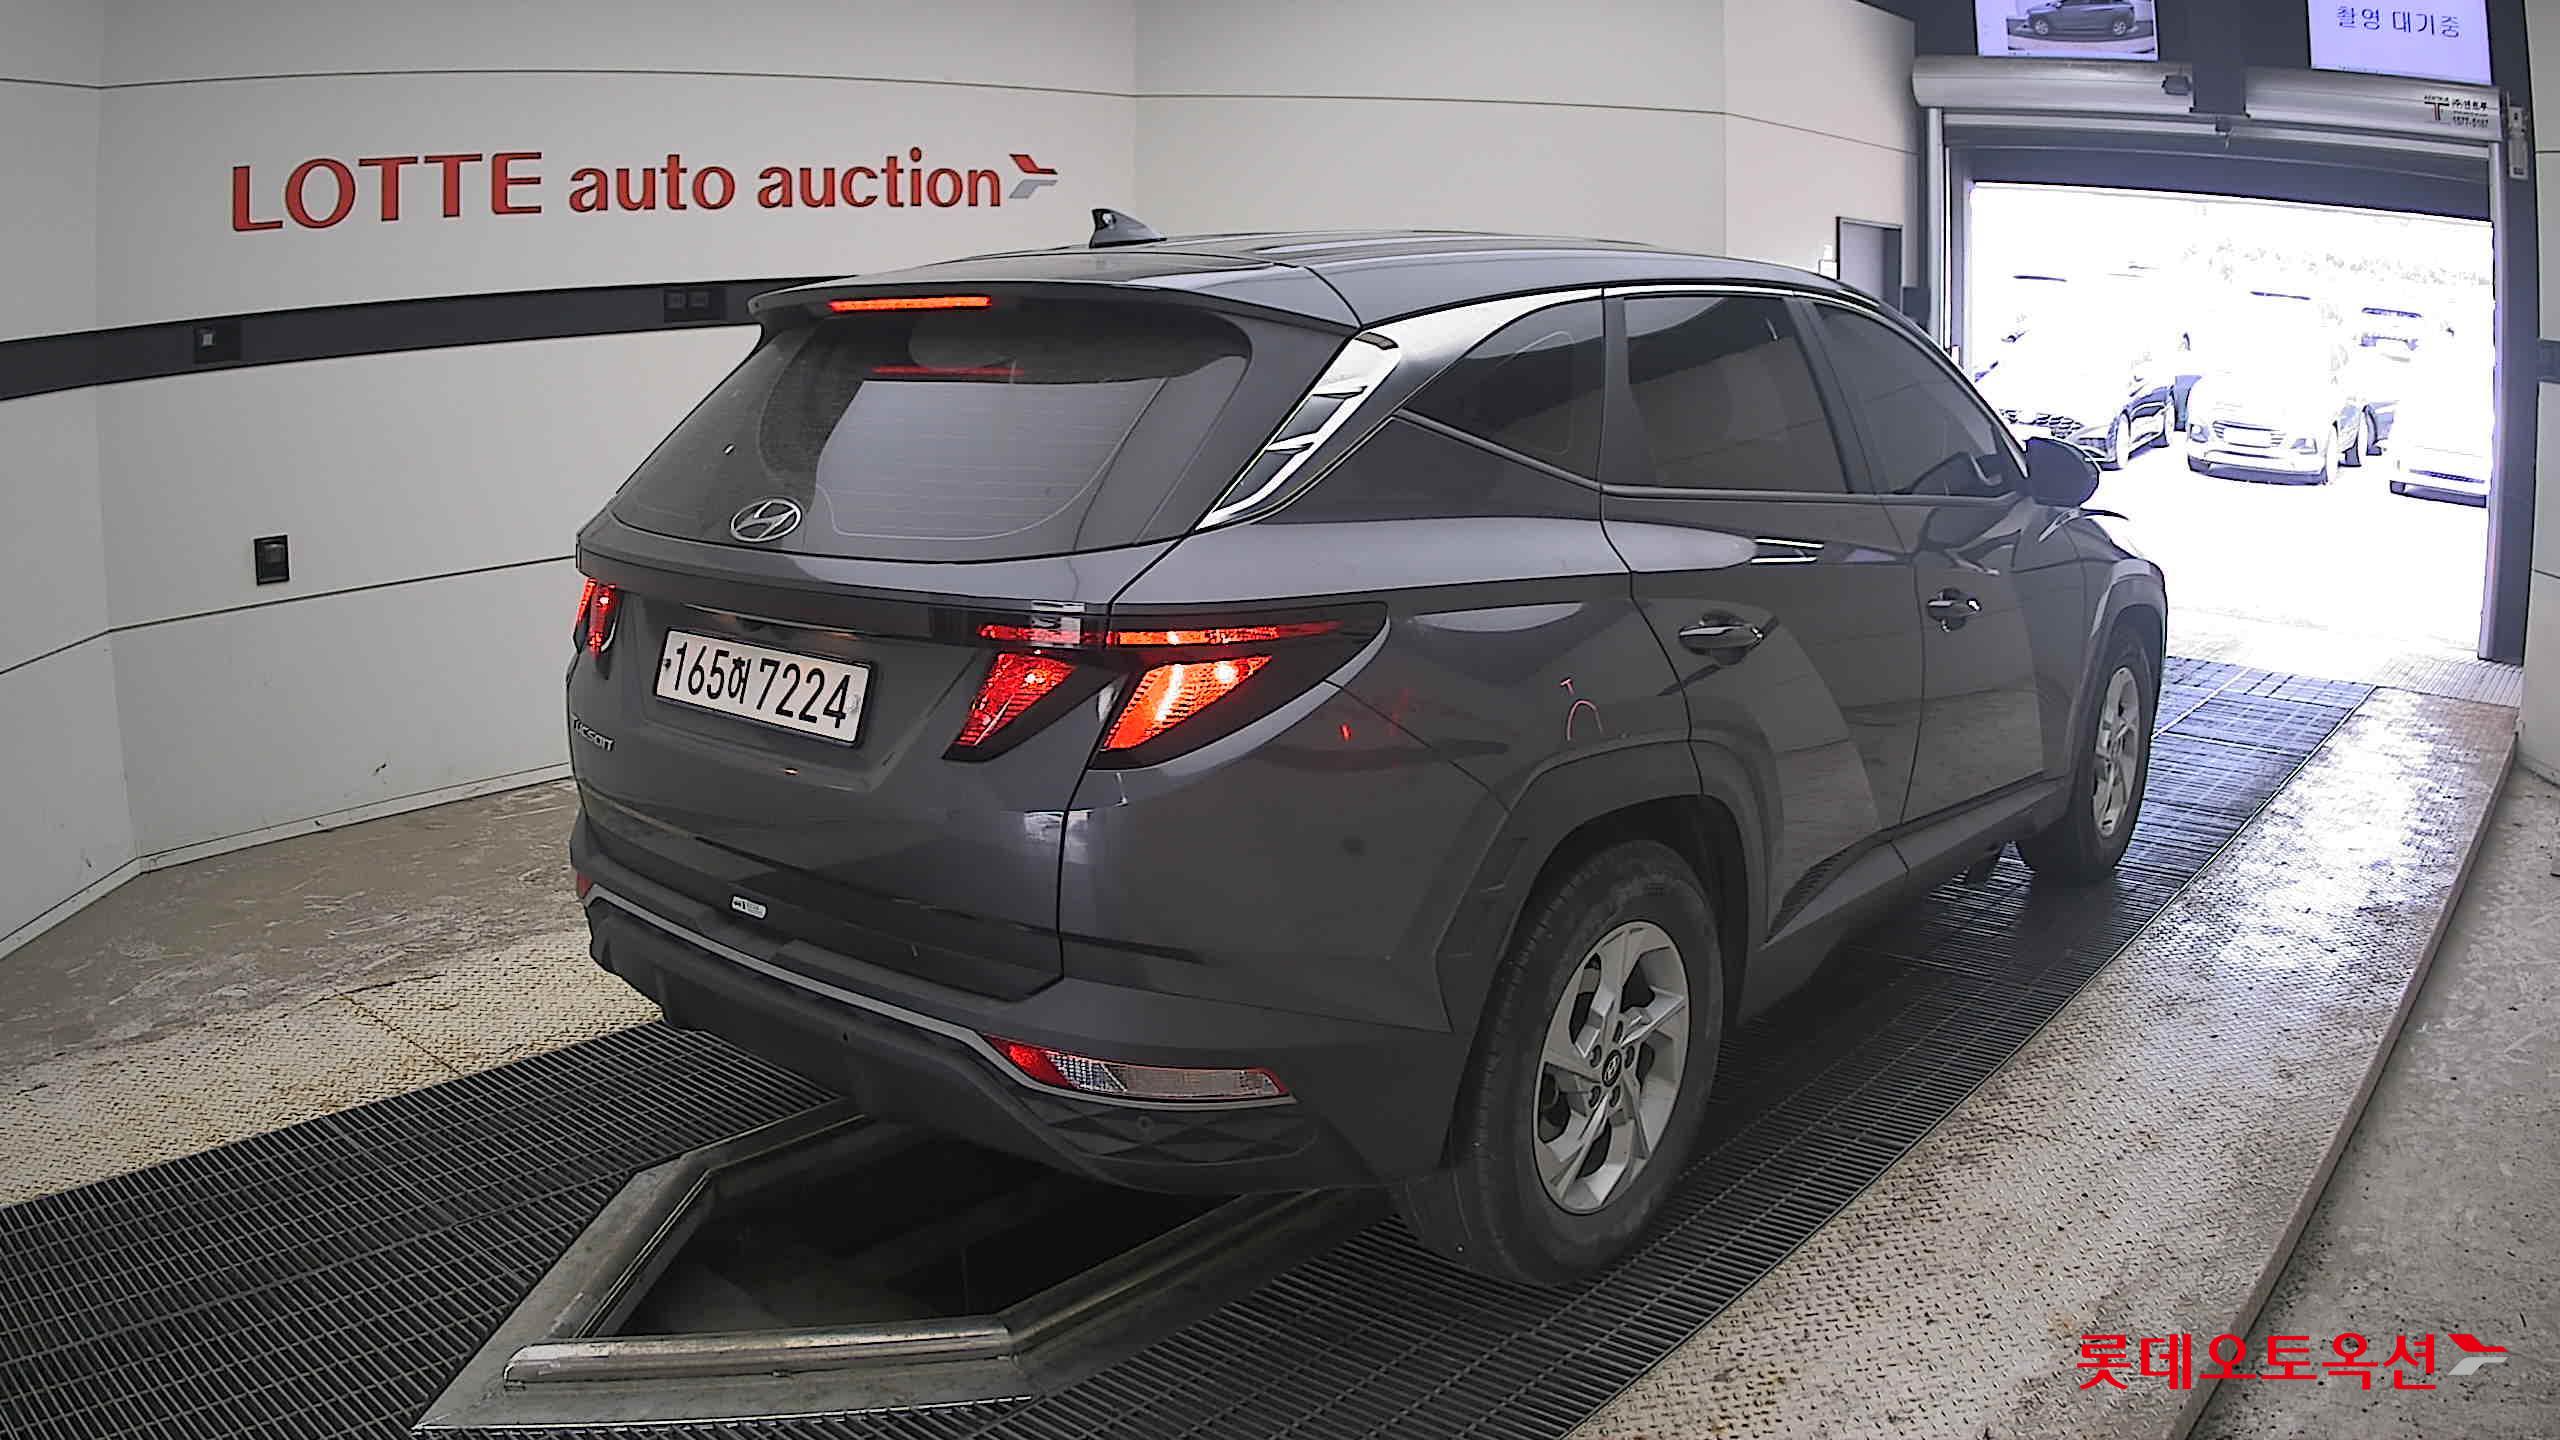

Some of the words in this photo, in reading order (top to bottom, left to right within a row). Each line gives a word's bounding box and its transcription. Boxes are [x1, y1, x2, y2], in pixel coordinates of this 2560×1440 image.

[2337, 6, 2381, 31] 촬영
[2392, 11, 2460, 38] 대기중
[231, 151, 542, 232] LOTTE
[567, 153, 736, 212] auto
[756, 146, 1003, 209] auction
[756, 657, 851, 729] 7224
